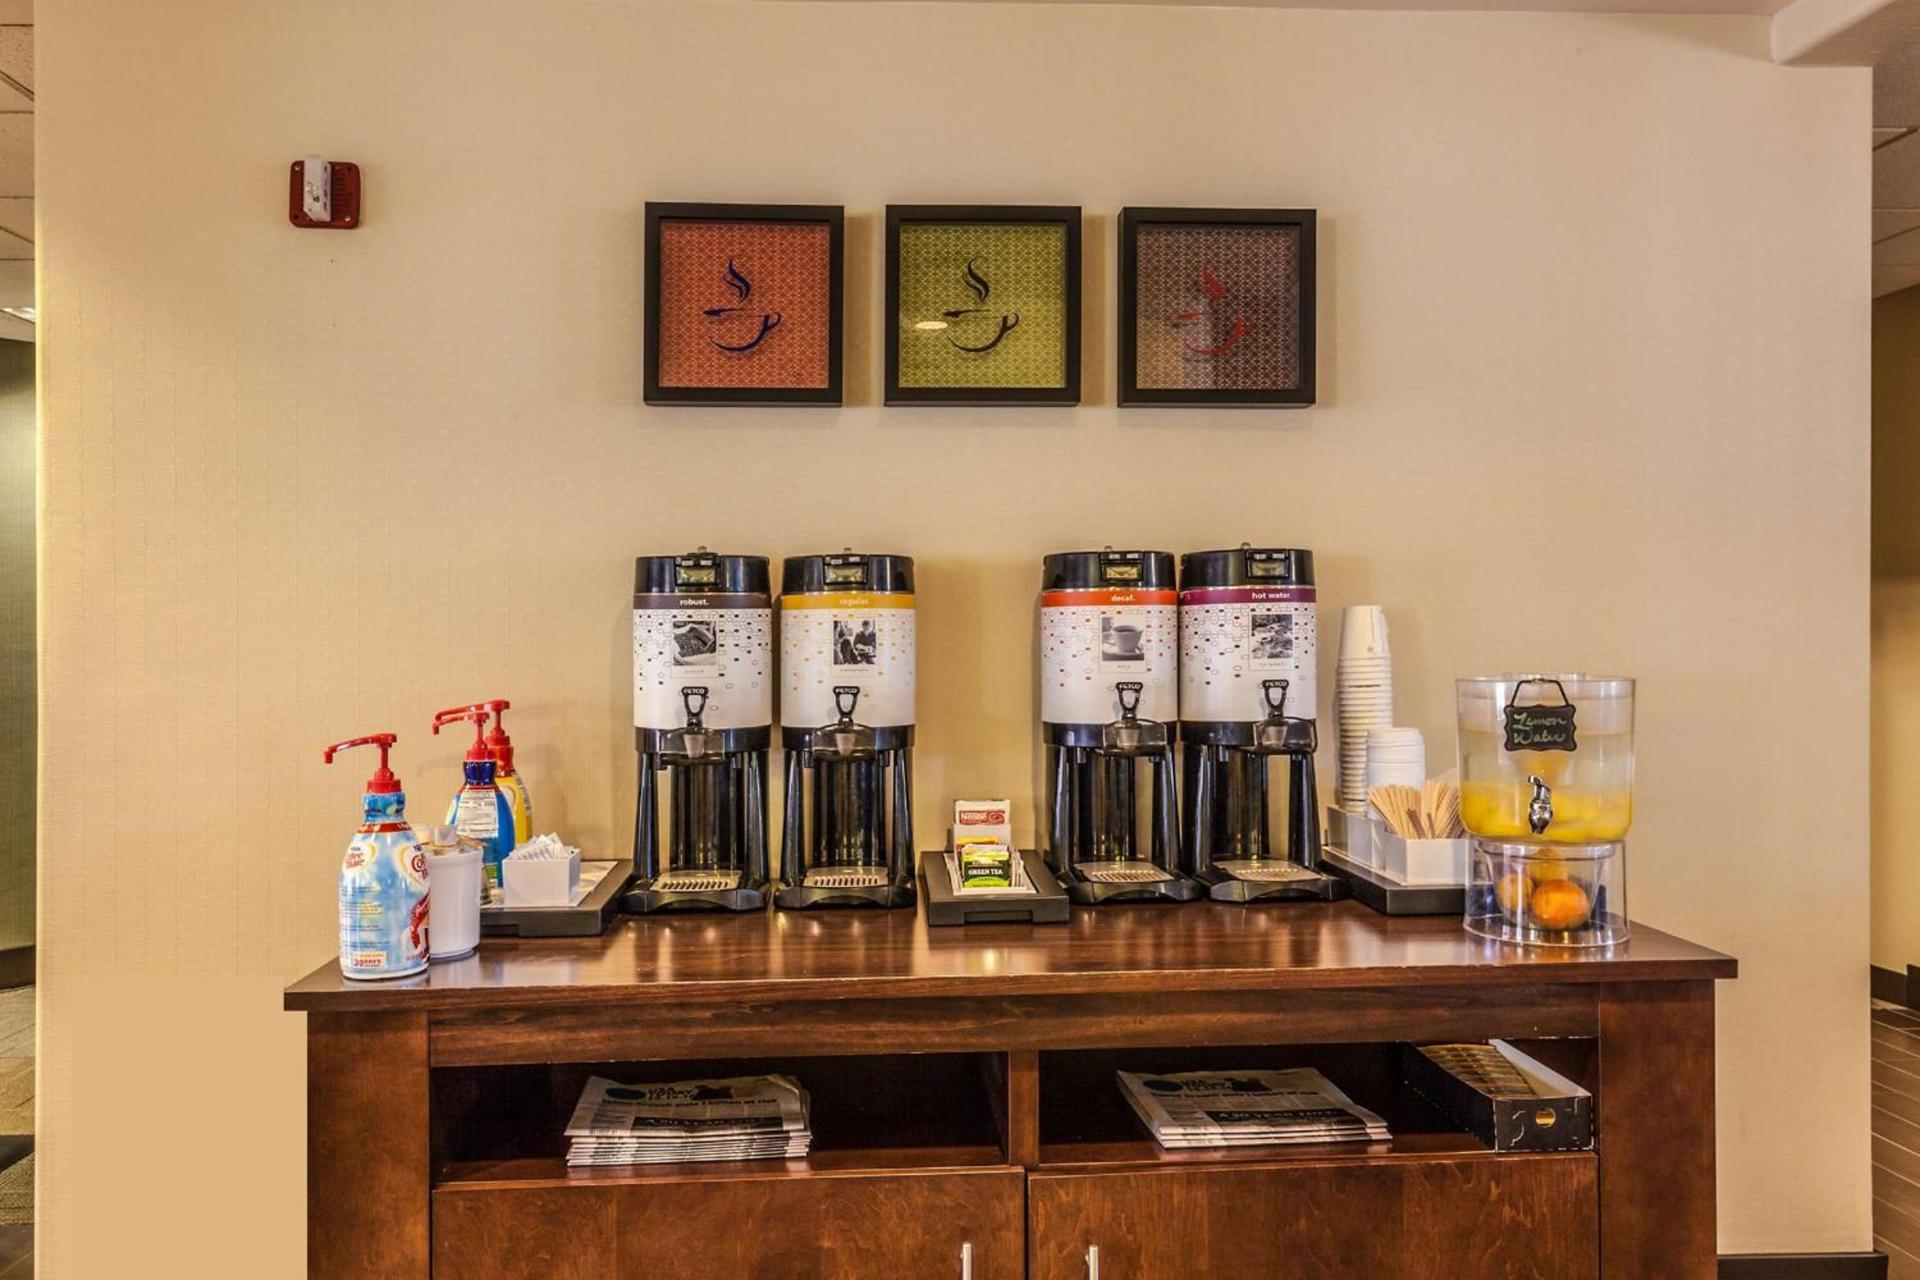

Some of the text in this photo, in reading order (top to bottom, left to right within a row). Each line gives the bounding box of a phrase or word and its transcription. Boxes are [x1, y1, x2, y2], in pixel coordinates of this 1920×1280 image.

[1251, 592, 1267, 600] hot
[1512, 711, 1568, 730] Lemon
[1513, 730, 1567, 745] Water
[968, 867, 1004, 876] GREEN TEA
